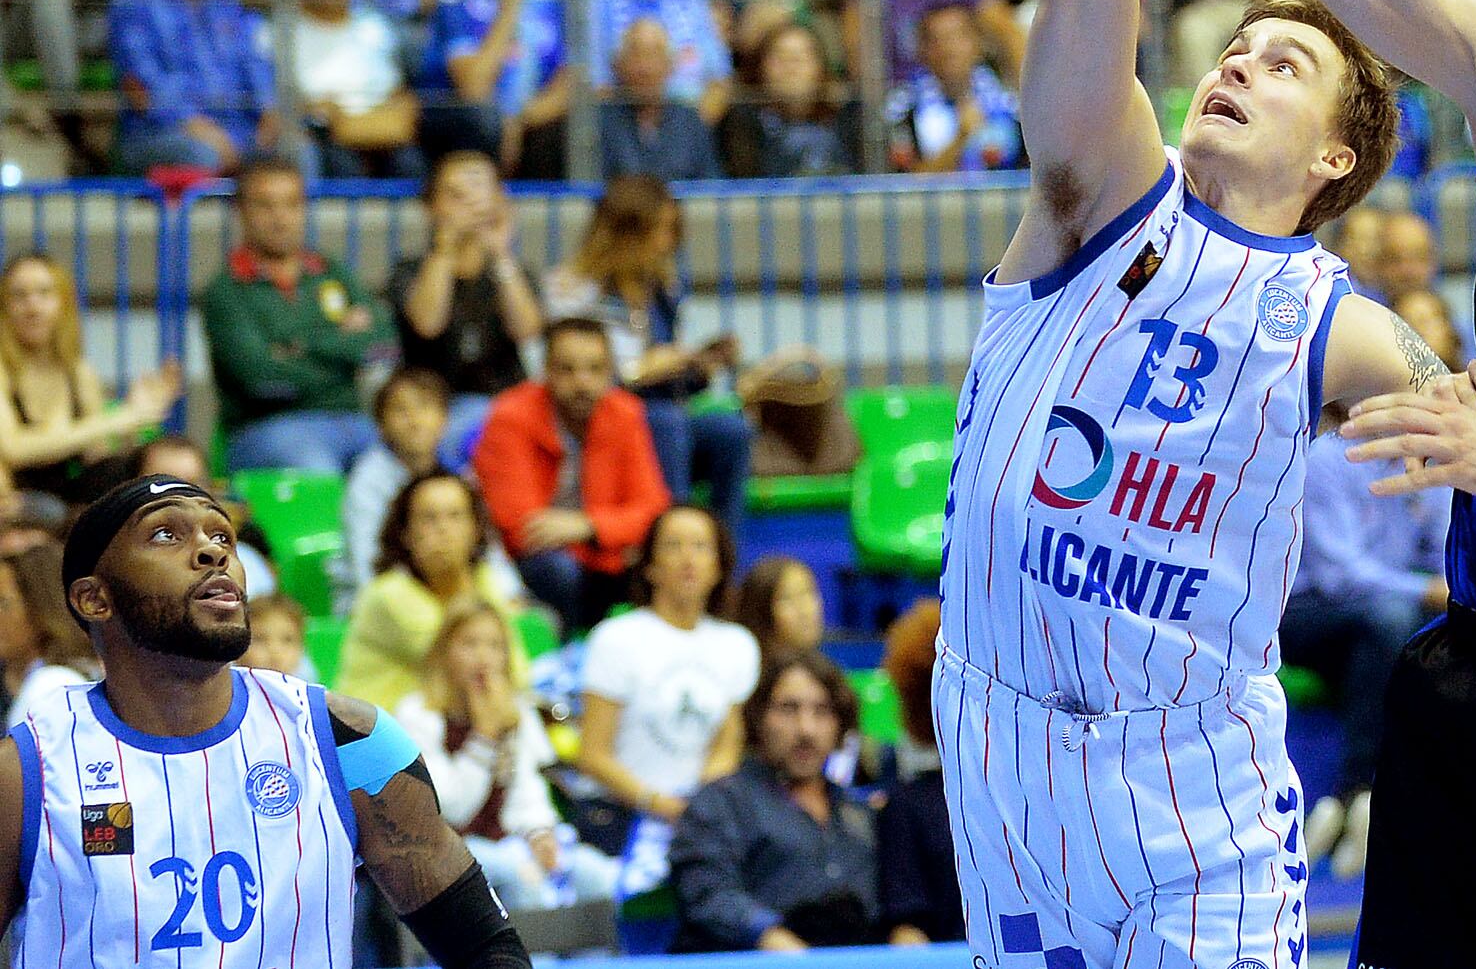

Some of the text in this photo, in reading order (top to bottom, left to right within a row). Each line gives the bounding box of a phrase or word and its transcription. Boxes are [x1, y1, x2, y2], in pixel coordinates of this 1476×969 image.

[1138, 318, 1220, 424] 13
[1108, 450, 1217, 534] HLA
[1020, 519, 1210, 621] LICANTE
[84, 781, 120, 792] hummel
[83, 808, 104, 823] Liga
[84, 826, 117, 842] LEB
[84, 841, 116, 854] ORO
[149, 850, 258, 952] 20
